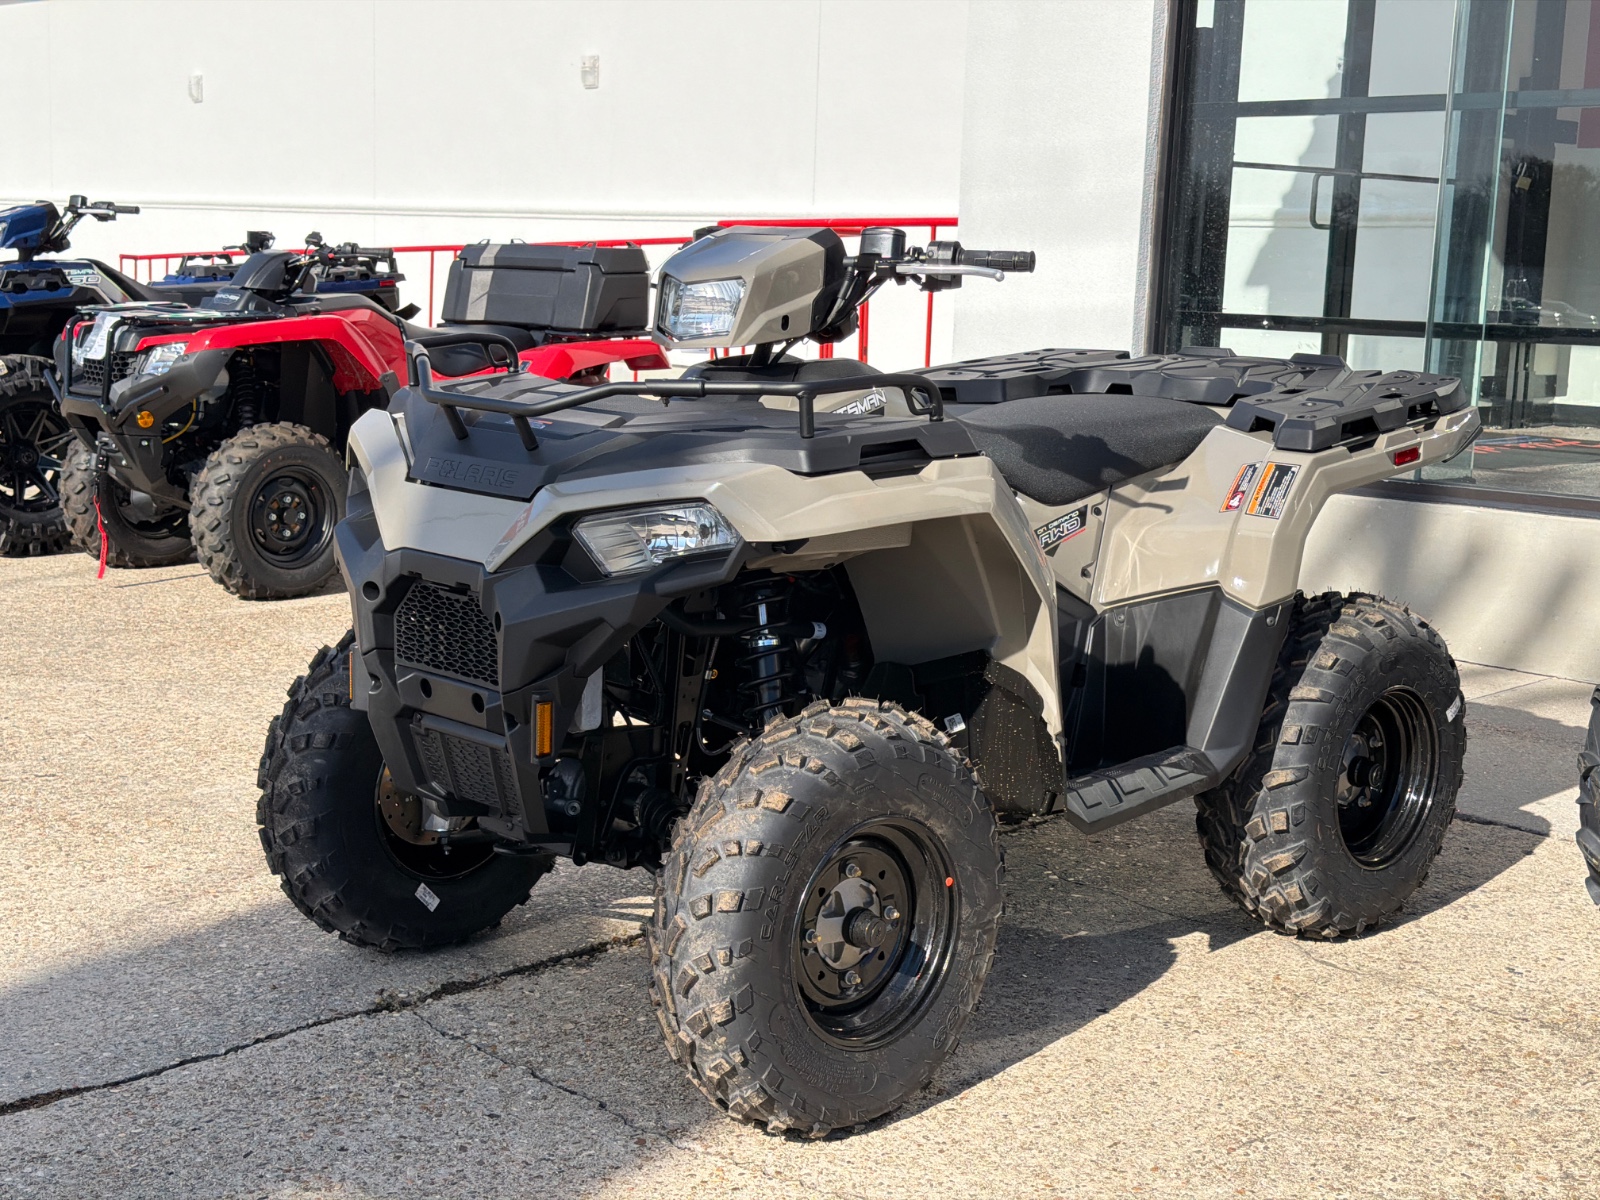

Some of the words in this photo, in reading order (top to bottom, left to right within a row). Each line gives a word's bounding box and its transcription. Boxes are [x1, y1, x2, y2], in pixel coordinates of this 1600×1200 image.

[423, 456, 519, 489] POLARIS
[1037, 526, 1047, 535] ON
[1048, 510, 1079, 529] DEMAND
[1039, 516, 1081, 548] AWD
[760, 806, 829, 941] CARLSTAR
